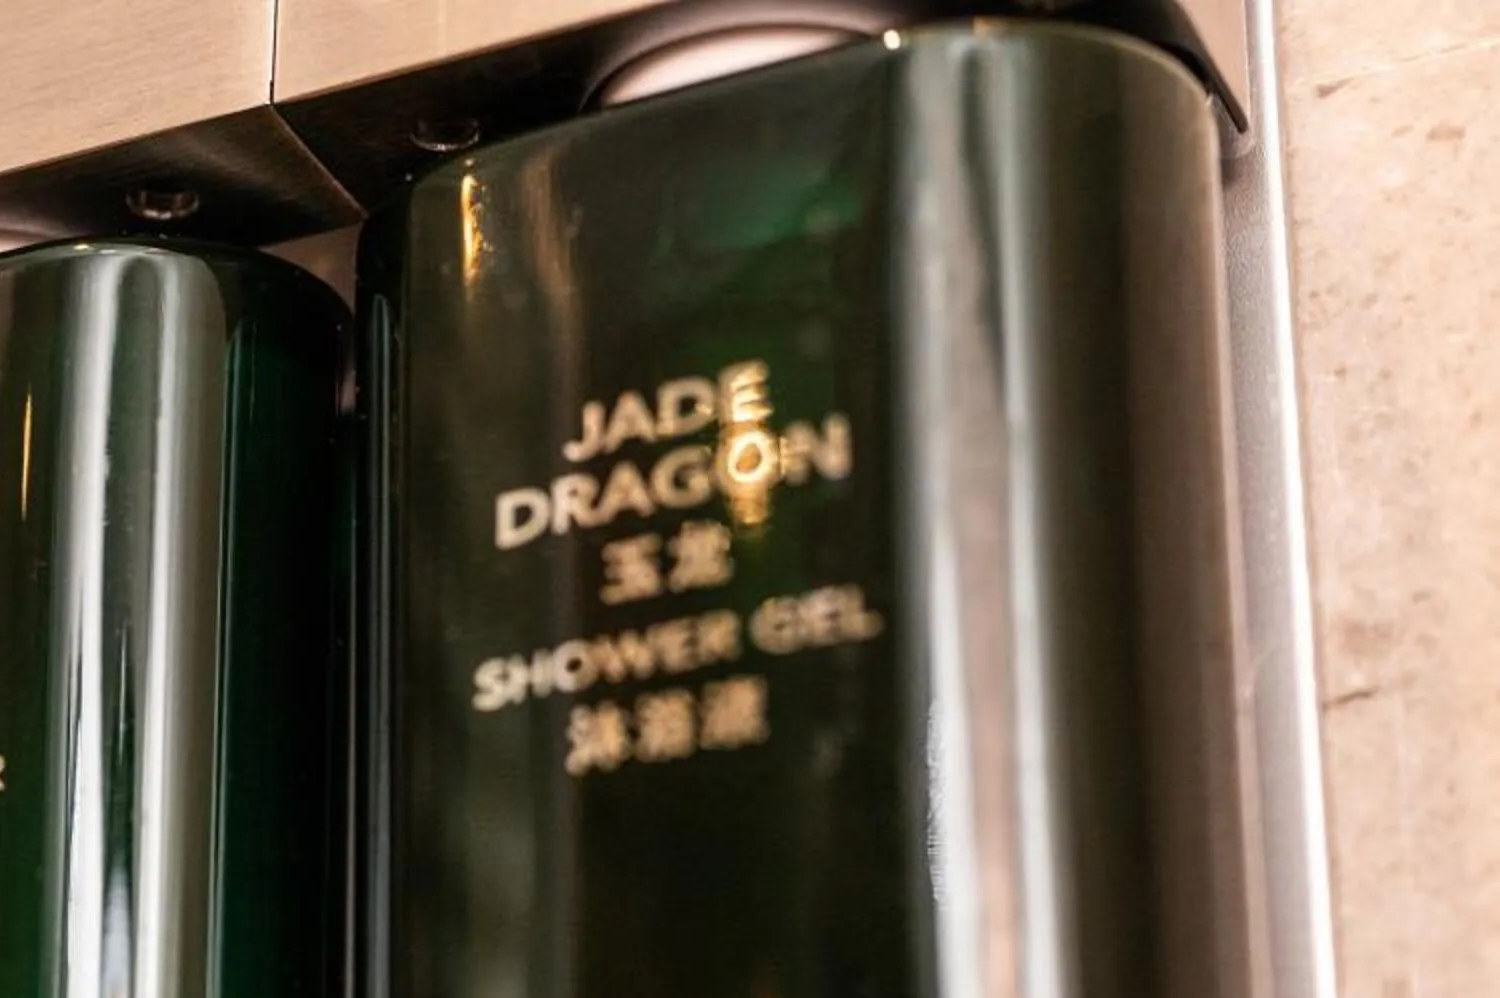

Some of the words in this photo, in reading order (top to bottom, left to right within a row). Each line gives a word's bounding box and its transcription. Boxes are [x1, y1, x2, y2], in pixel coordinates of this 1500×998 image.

[563, 360, 772, 463] JADE
[494, 413, 851, 550] DRAGON
[472, 610, 740, 711] SHOWER
